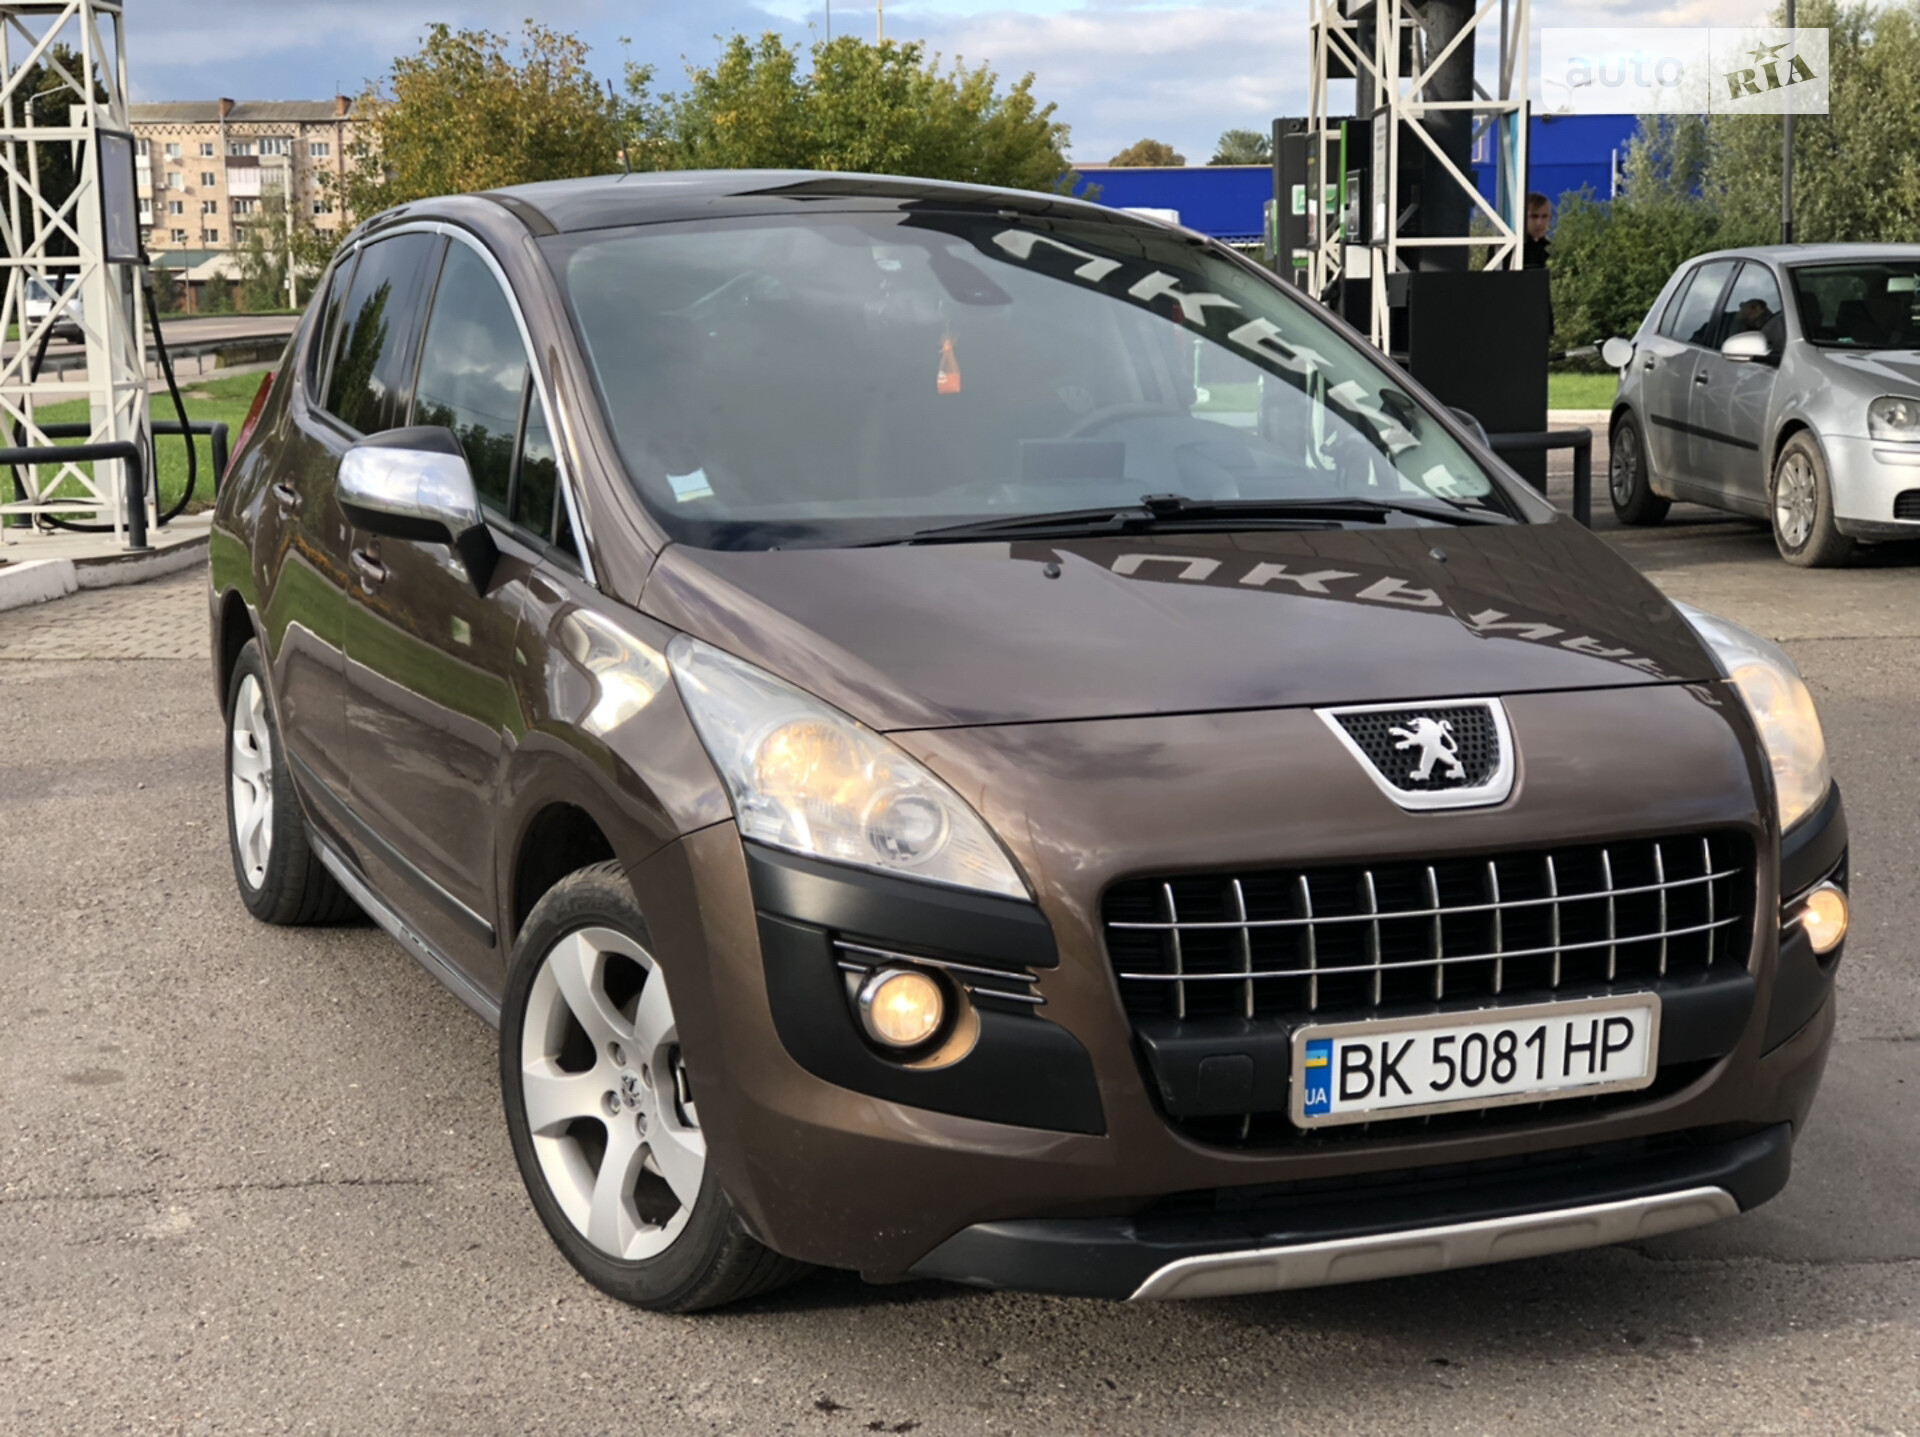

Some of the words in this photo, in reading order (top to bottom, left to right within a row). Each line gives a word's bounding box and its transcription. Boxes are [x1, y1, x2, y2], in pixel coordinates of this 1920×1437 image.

[1339, 1039, 1415, 1102] BK
[1429, 1025, 1547, 1092] 5081
[1563, 1016, 1635, 1077] HP
[1304, 1087, 1329, 1106] UA
